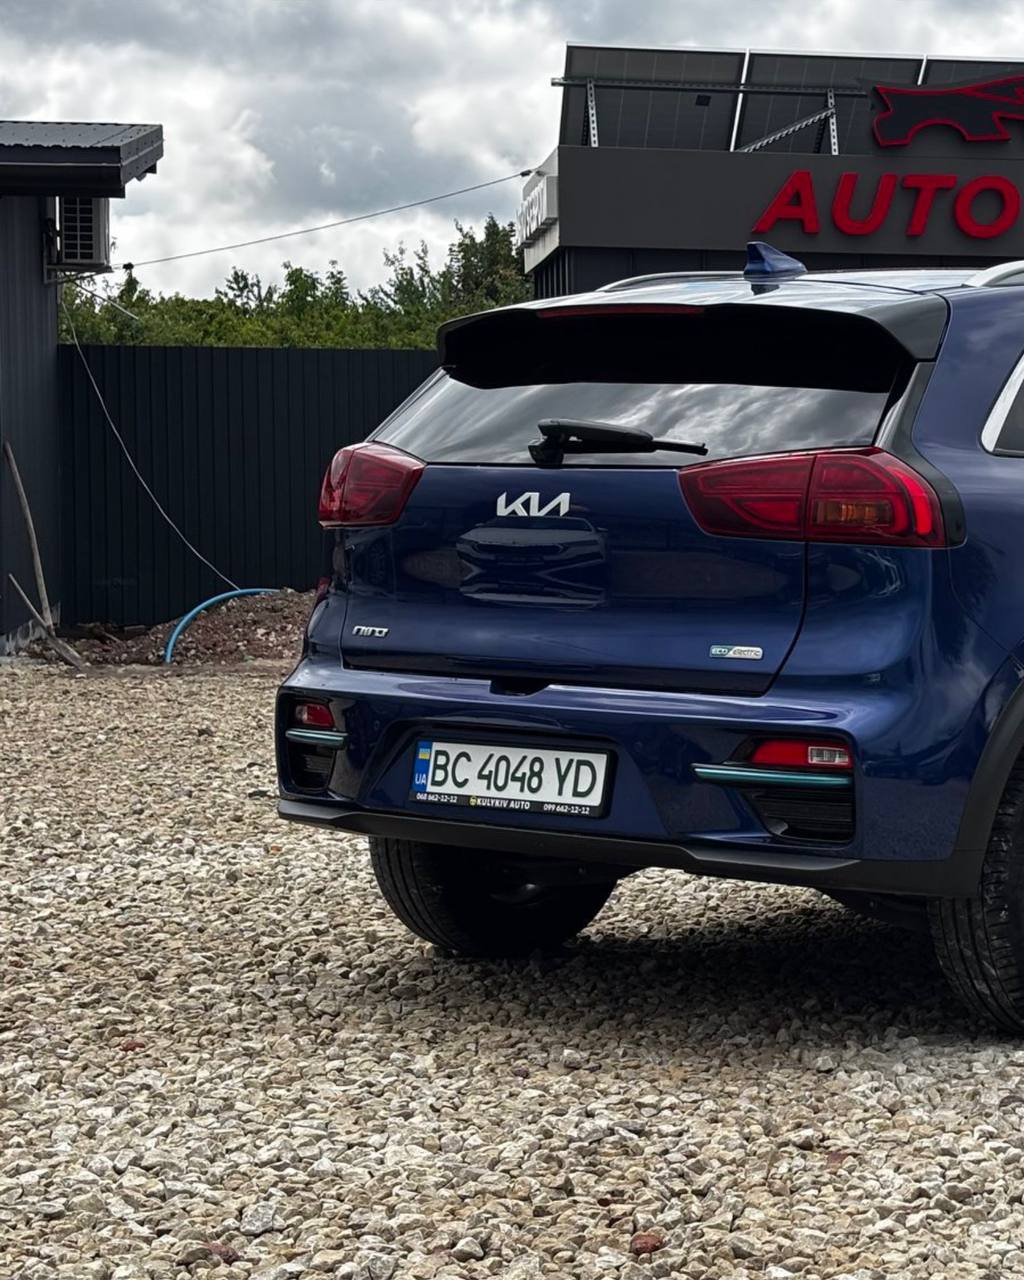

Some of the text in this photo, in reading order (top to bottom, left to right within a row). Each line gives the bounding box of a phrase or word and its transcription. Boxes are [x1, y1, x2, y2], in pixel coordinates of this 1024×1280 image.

[752, 170, 1022, 239] AUTO
[497, 492, 570, 517] KIA
[415, 773, 427, 785] UA
[430, 750, 597, 798] BC 4048 YD
[477, 798, 530, 809] KULYKIV AUTO
